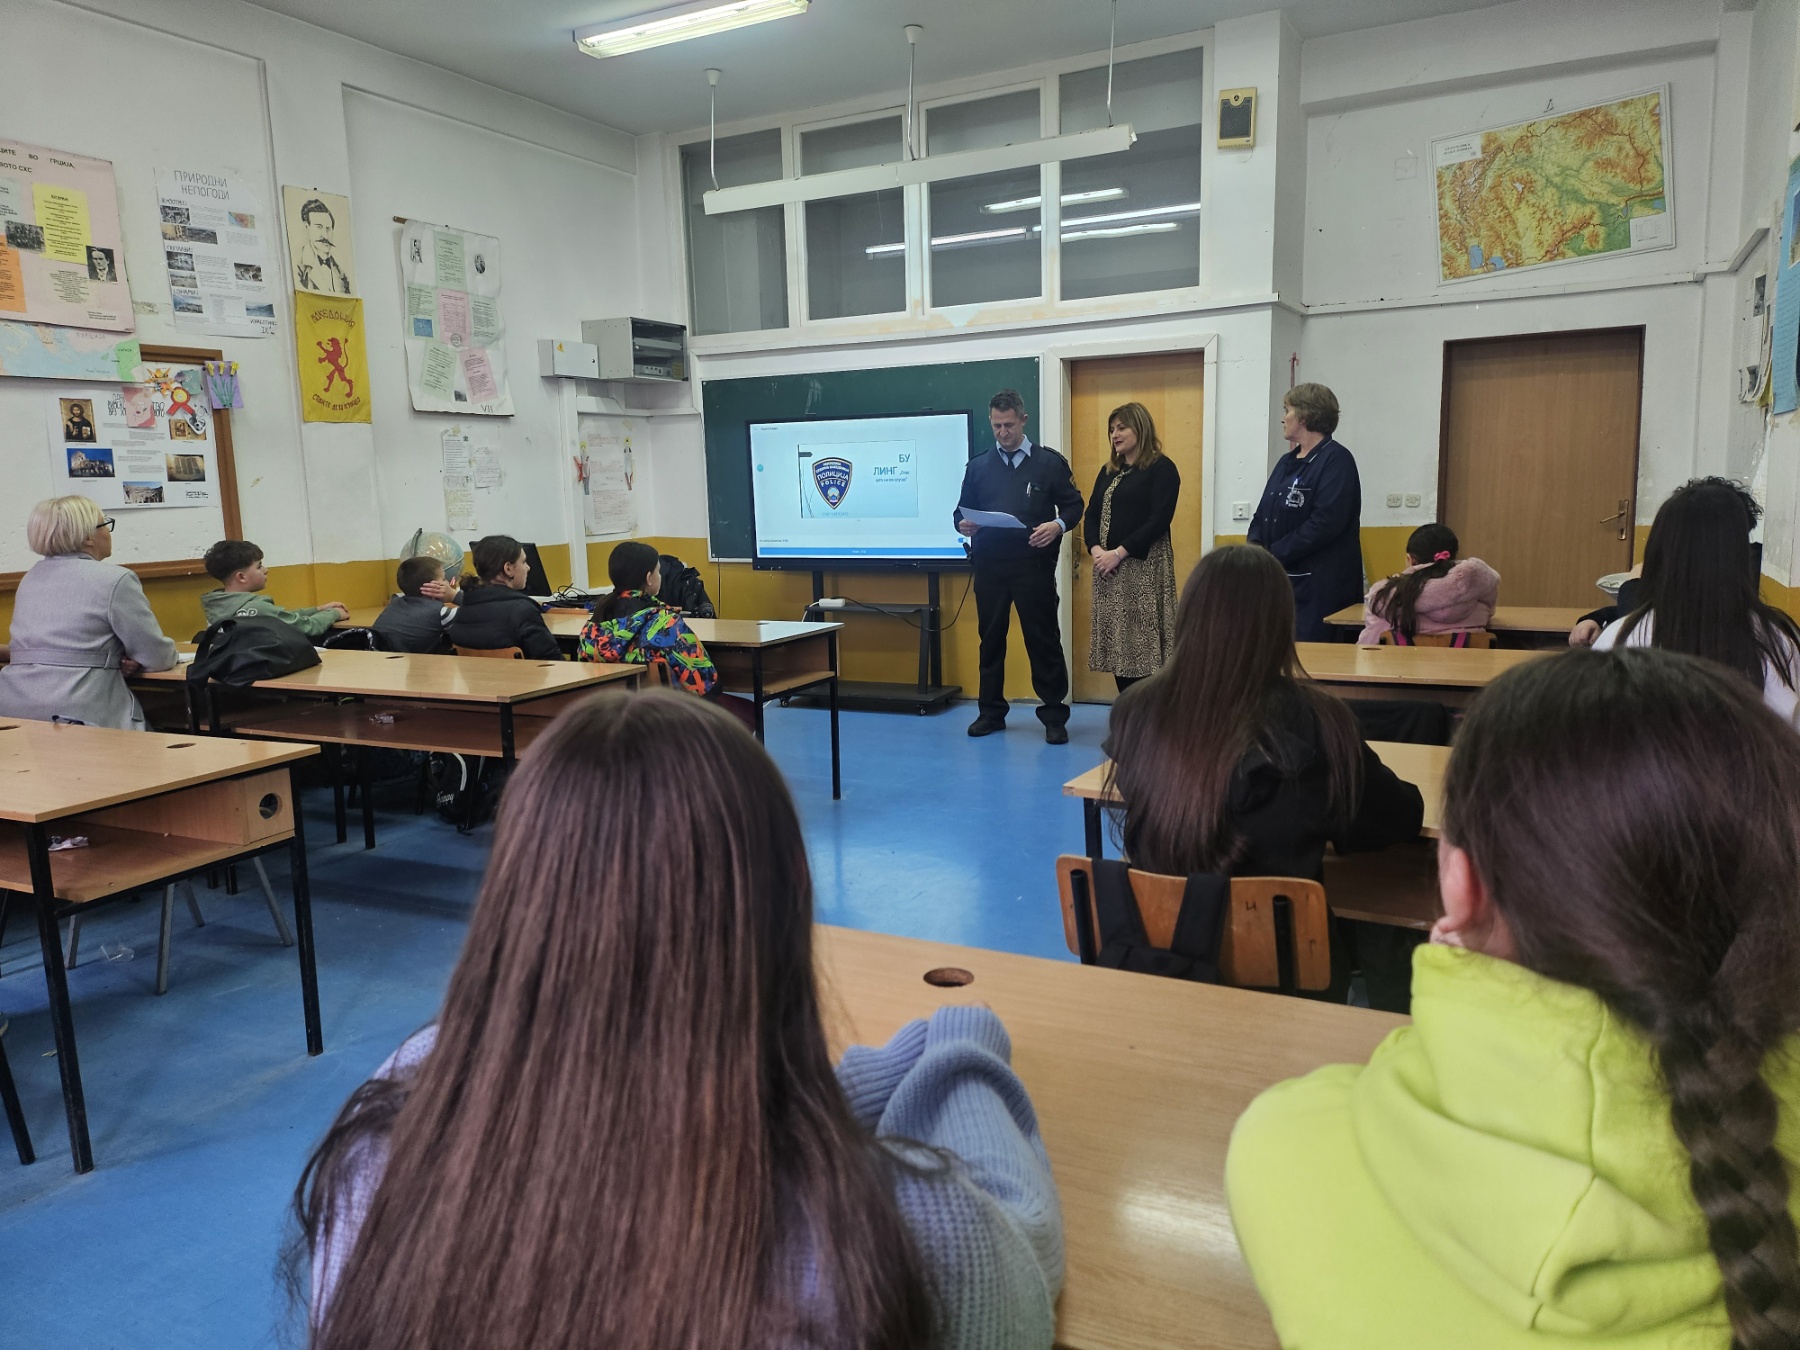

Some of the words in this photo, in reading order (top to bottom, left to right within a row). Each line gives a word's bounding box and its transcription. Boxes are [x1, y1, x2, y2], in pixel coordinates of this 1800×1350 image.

[28, 153, 39, 161] ВО
[18, 165, 33, 173] СХС
[173, 170, 228, 188] ПРИРОДНИ
[181, 184, 231, 200] НЕПОГОДИ
[899, 453, 911, 463] БУ
[816, 471, 849, 481] ПОЛИЦИЈА
[873, 466, 898, 476] ЛИНГ
[820, 479, 846, 488] POLICE
